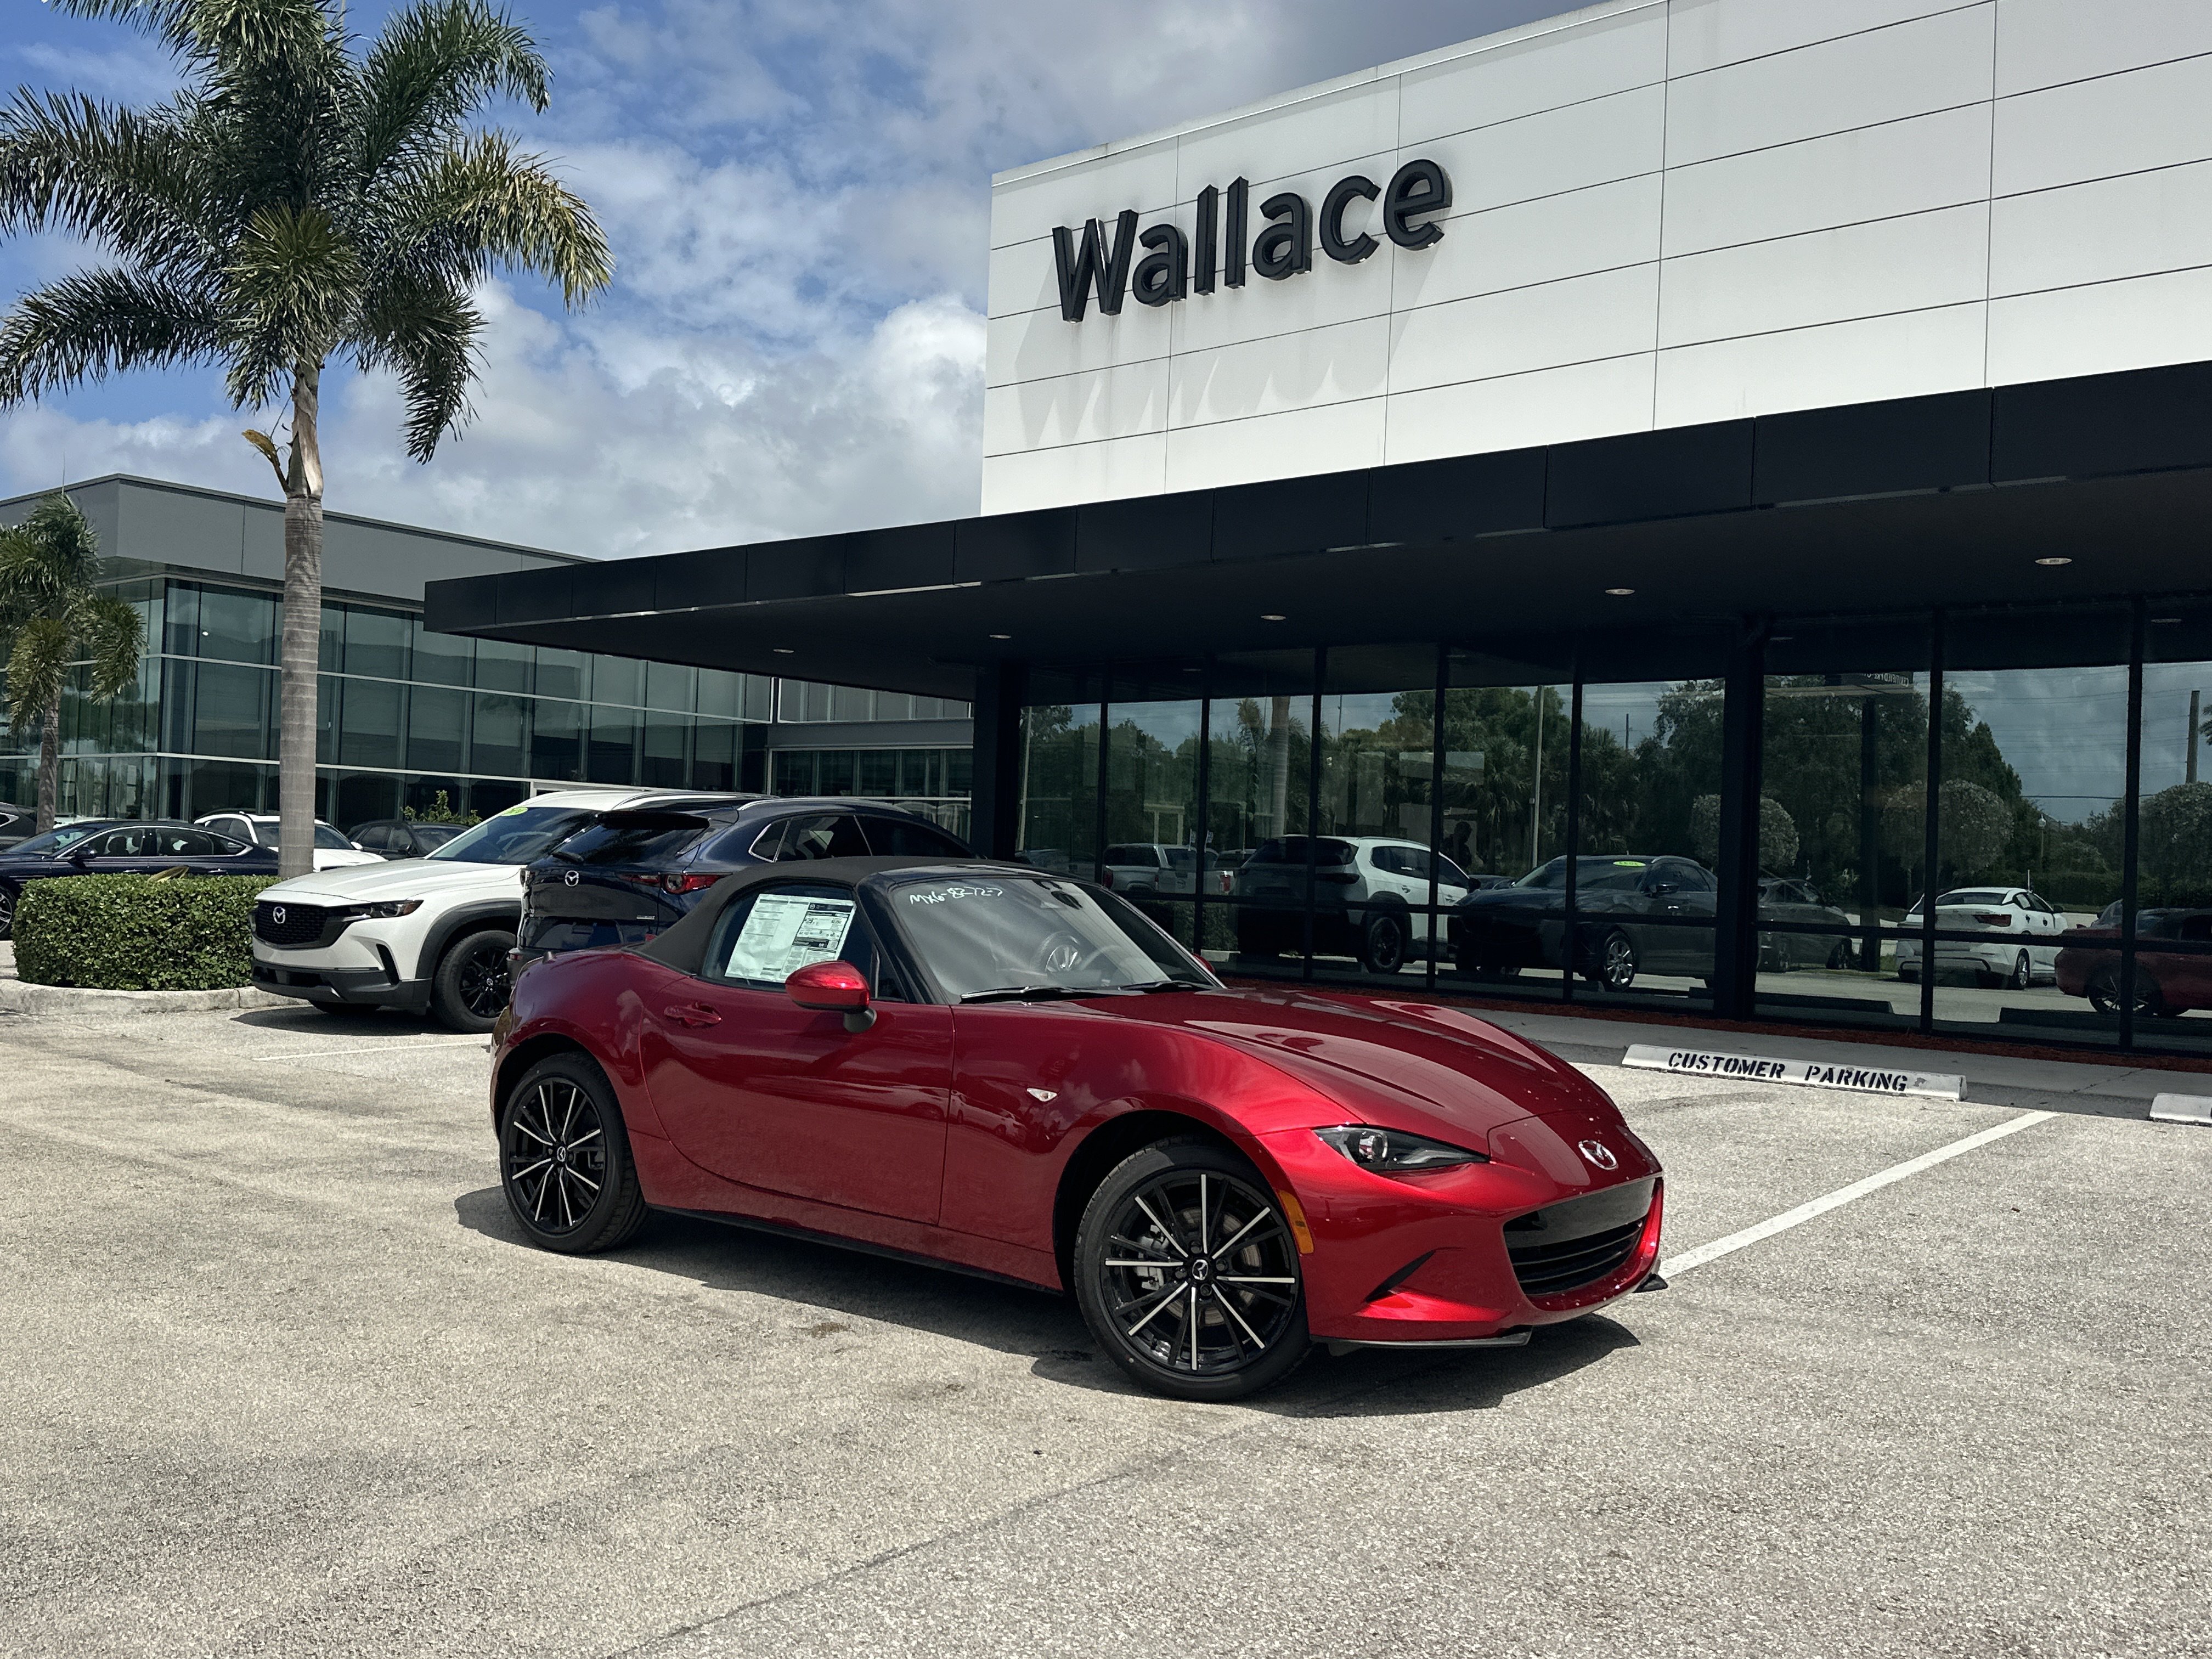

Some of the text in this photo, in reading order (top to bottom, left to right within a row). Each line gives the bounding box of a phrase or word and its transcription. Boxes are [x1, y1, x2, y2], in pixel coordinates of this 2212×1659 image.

[1052, 159, 1453, 323] Wallace
[1668, 1052, 1908, 1092] CUSTOMER PARKING
